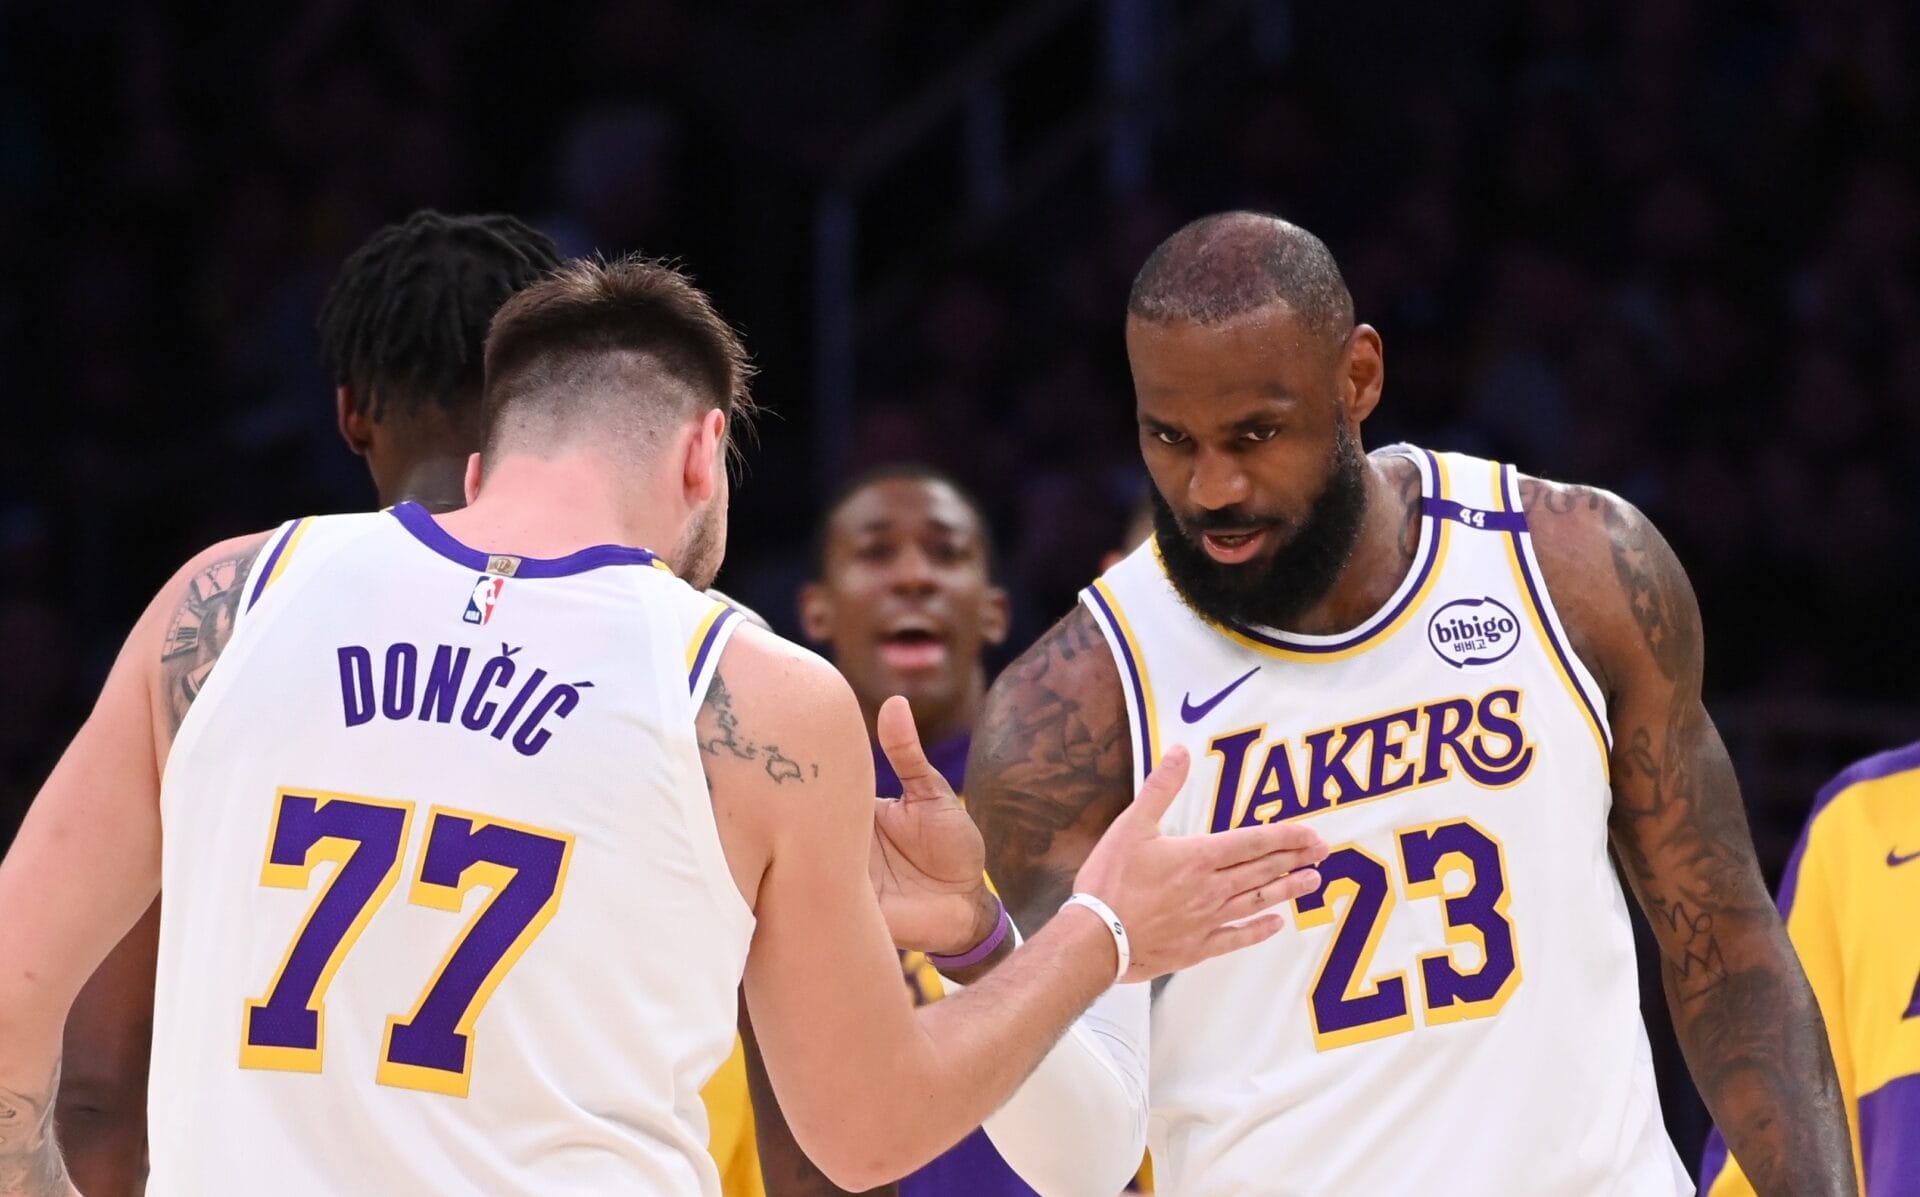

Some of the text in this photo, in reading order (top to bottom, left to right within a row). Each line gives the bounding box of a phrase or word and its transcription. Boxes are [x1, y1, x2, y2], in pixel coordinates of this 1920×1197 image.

[1459, 508, 1487, 528] 44
[1435, 615, 1514, 643] bibigo
[1453, 638, 1487, 654] 비비고
[336, 642, 594, 757] DONČIĆ
[1206, 687, 1537, 835] LAKERS
[238, 785, 576, 1099] 77
[1291, 815, 1523, 1054] 23
